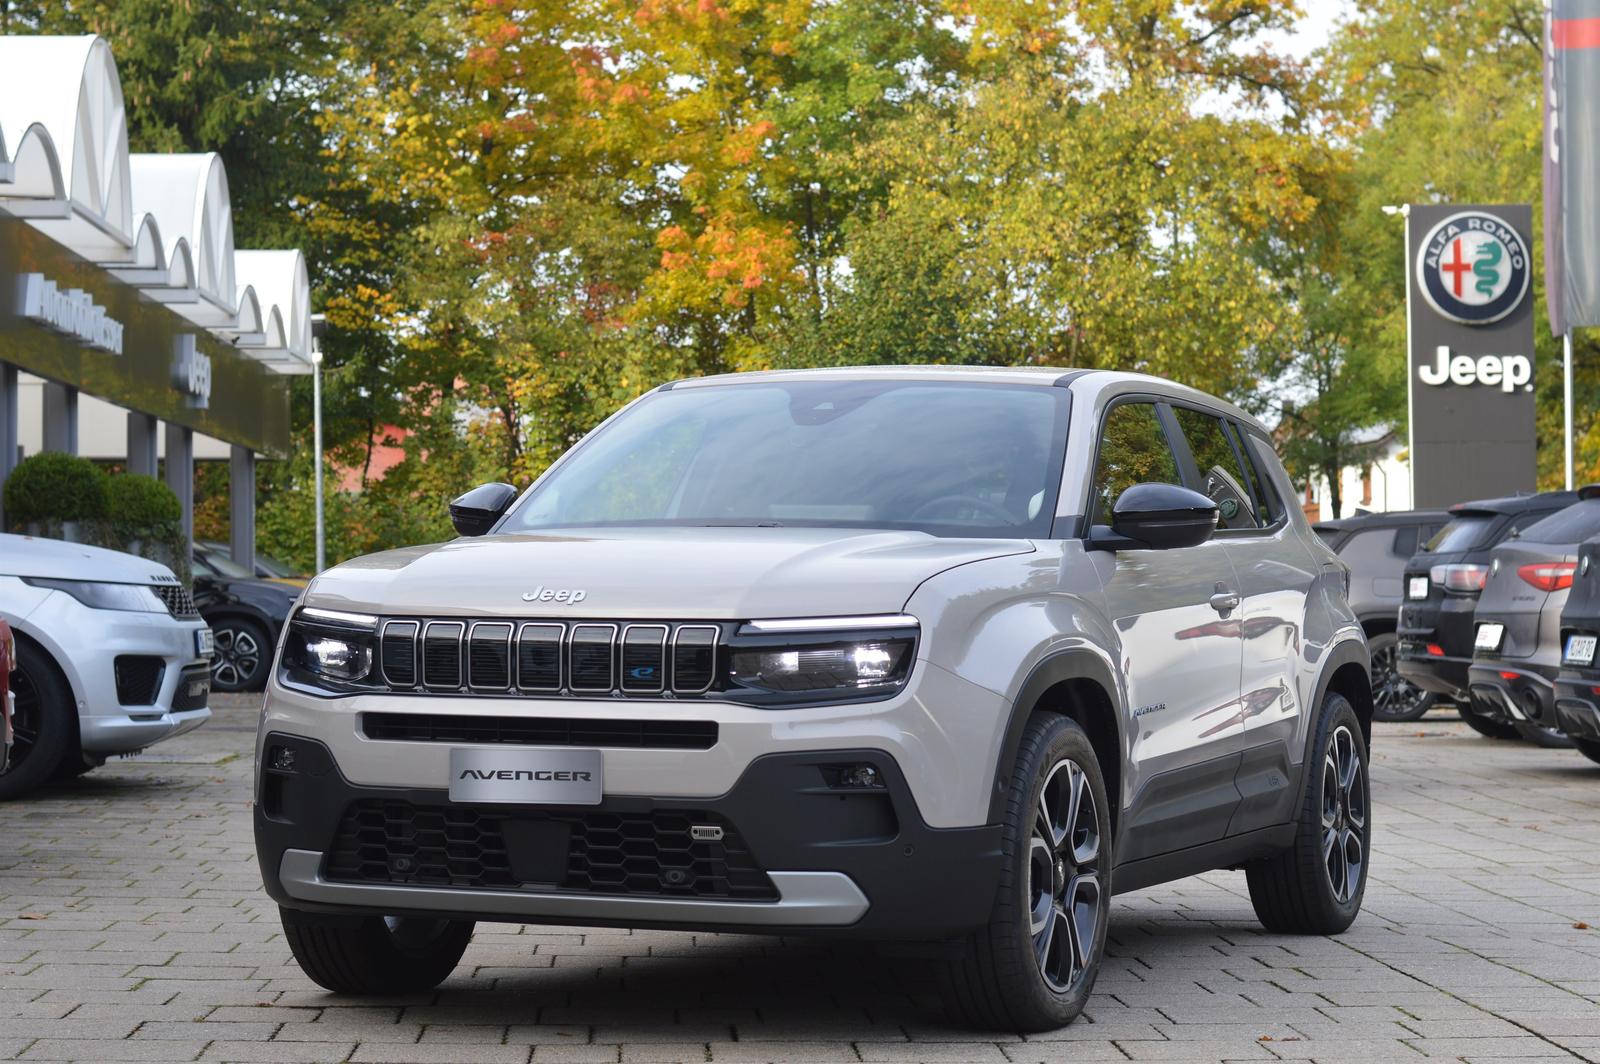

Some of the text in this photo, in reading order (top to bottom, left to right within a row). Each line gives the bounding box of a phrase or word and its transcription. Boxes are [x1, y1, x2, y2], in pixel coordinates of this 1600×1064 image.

[1426, 218, 1524, 270] ALFA ROMEO
[1418, 346, 1532, 392] Jeep
[521, 585, 588, 605] Jeep
[459, 769, 592, 782] AVENGER
